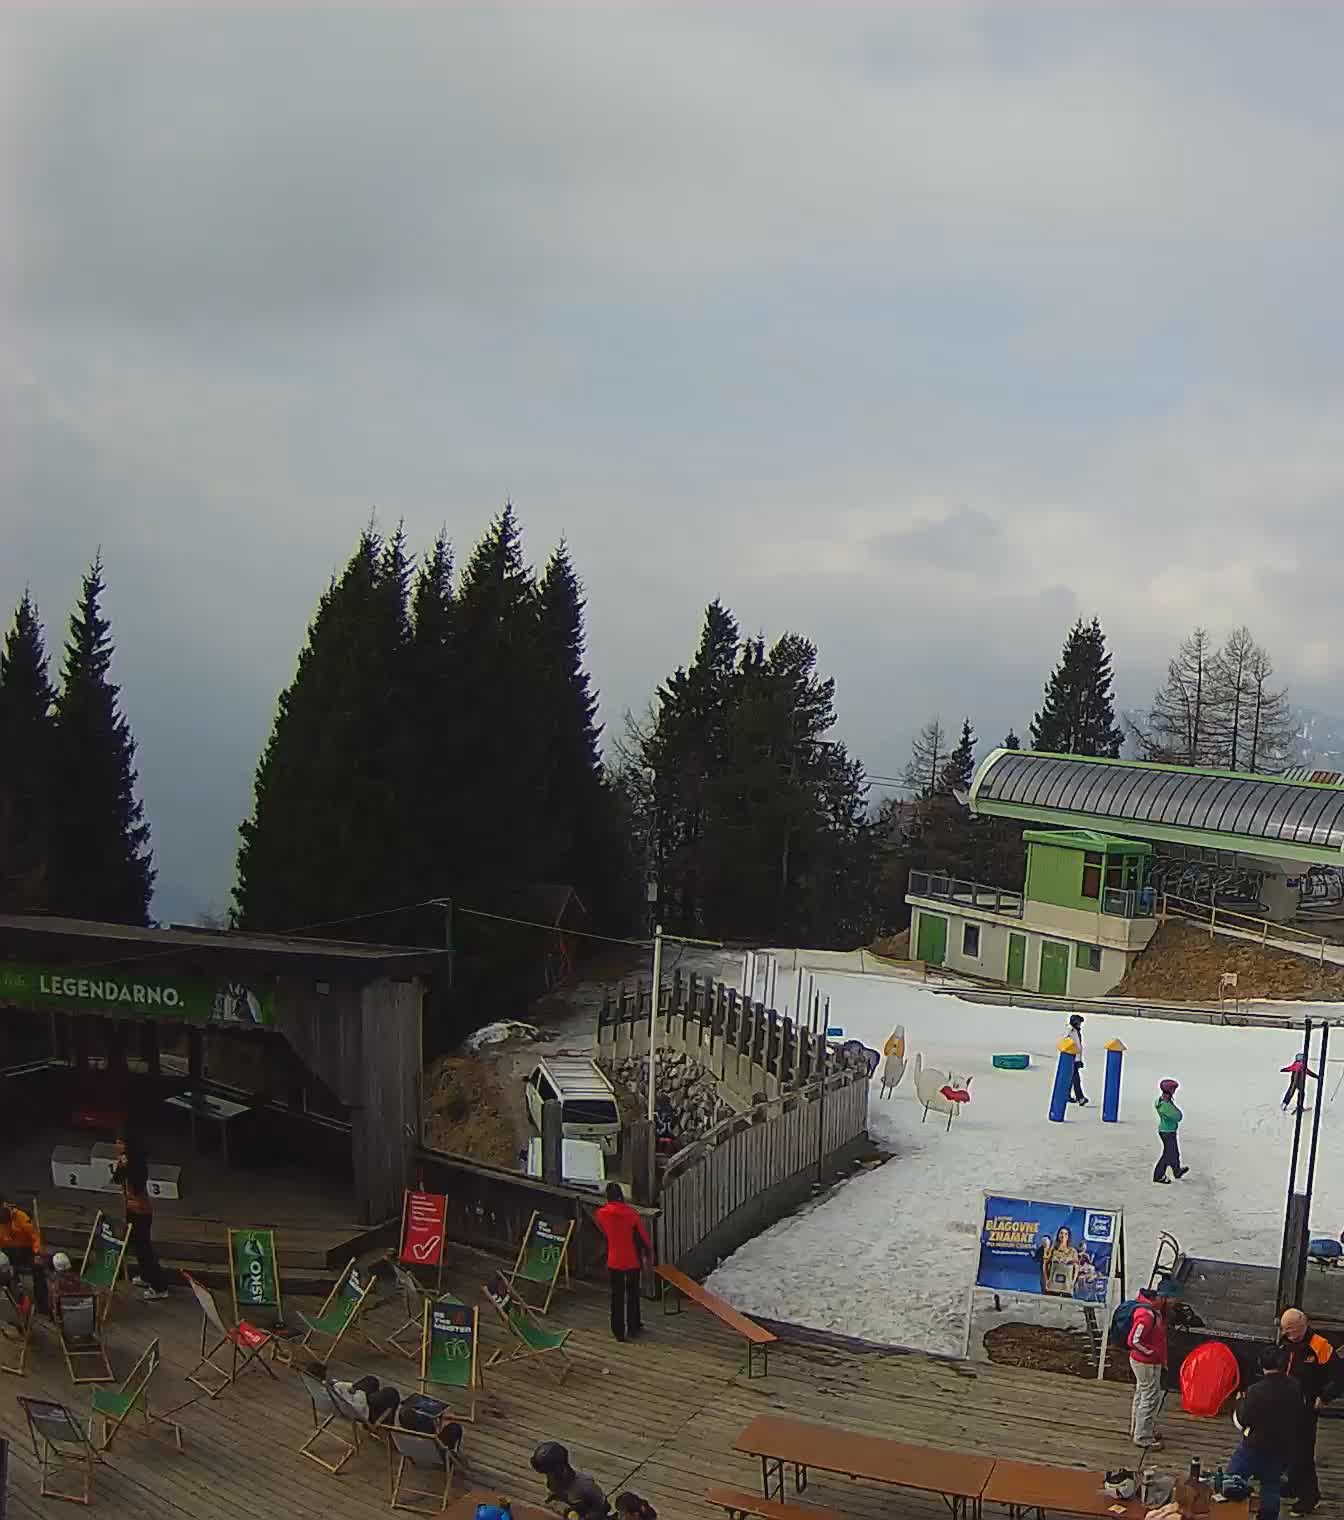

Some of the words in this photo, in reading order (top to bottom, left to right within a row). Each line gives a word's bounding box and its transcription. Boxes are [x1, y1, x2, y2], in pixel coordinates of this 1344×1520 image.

[40, 975, 185, 1007] LEGENDARNO.
[151, 1182, 161, 1196] 3
[986, 1219, 1039, 1233] BLAGOVNE
[990, 1230, 1034, 1243] ZNAMKE
